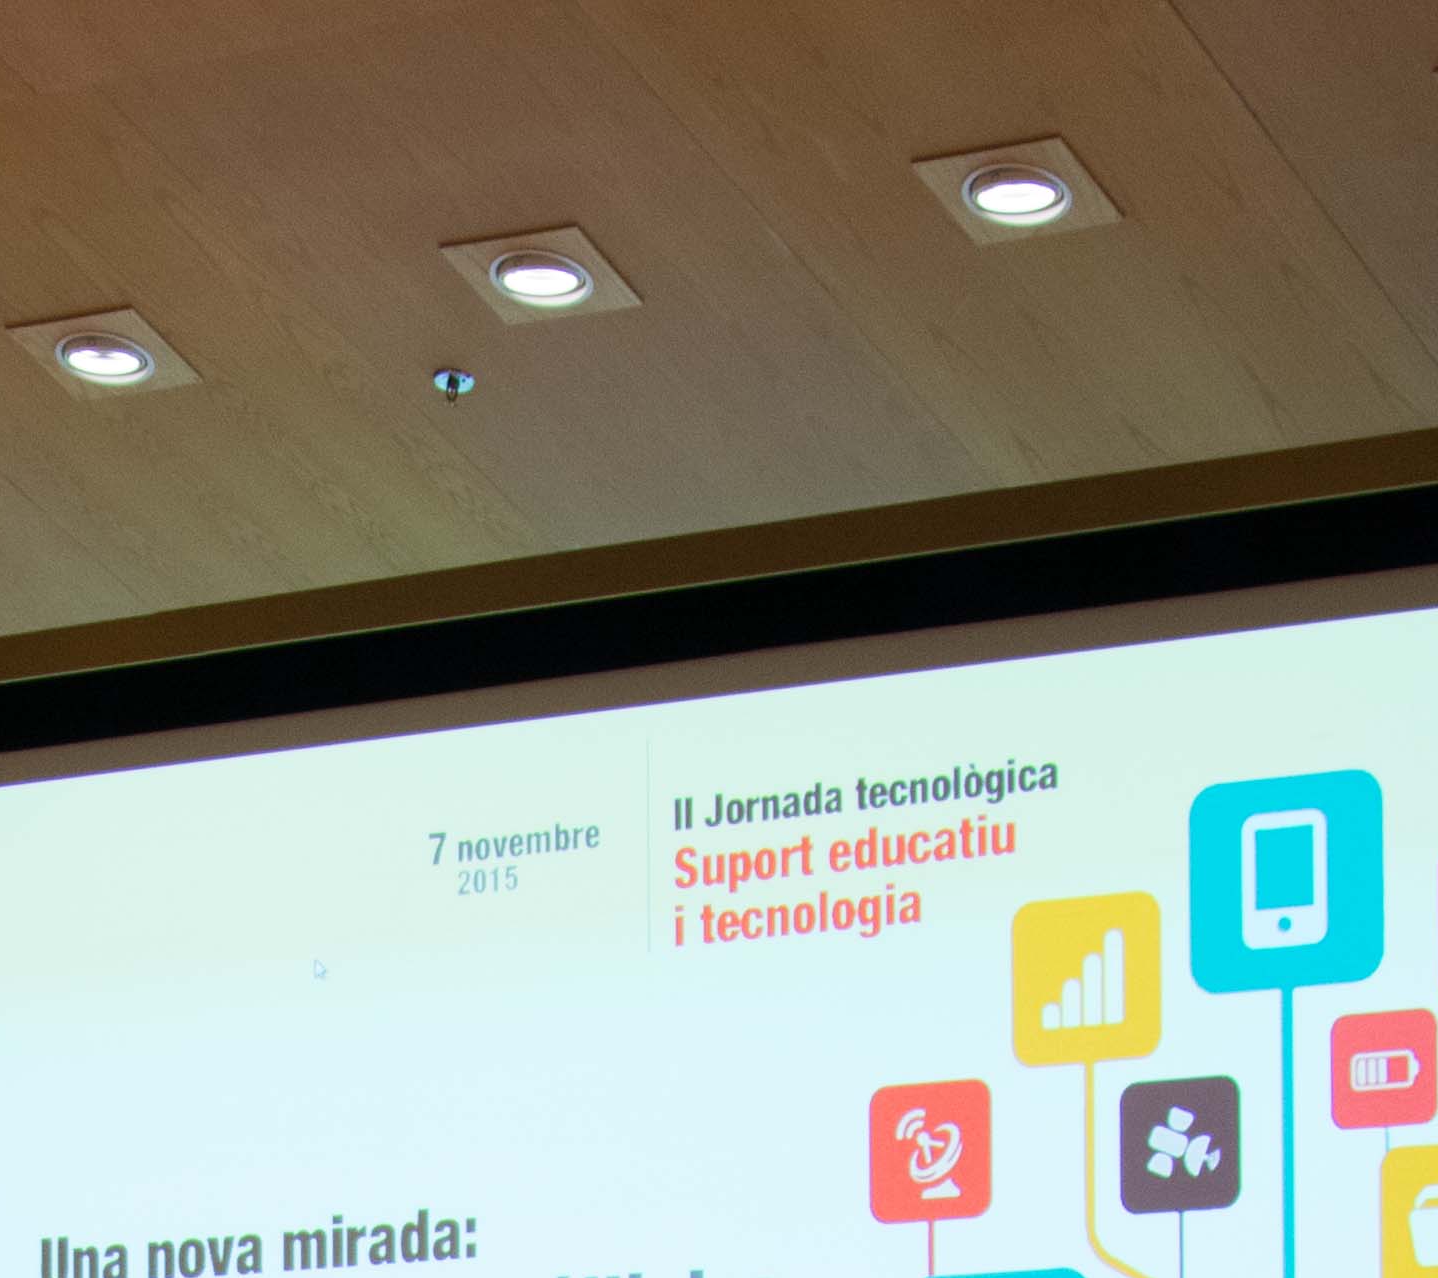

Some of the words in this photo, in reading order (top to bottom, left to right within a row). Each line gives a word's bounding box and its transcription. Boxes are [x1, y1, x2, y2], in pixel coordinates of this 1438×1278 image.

[673, 797, 693, 830] II
[704, 782, 843, 828] Jornada
[856, 761, 1059, 811] tecnològica
[428, 833, 446, 865] 7
[457, 823, 601, 863] novembre
[673, 835, 814, 892] Suport
[828, 815, 1017, 873] educatiu
[457, 866, 519, 896] 2015
[673, 906, 685, 947] i
[701, 884, 922, 943] tecnologia
[282, 1208, 478, 1271] mirada:
